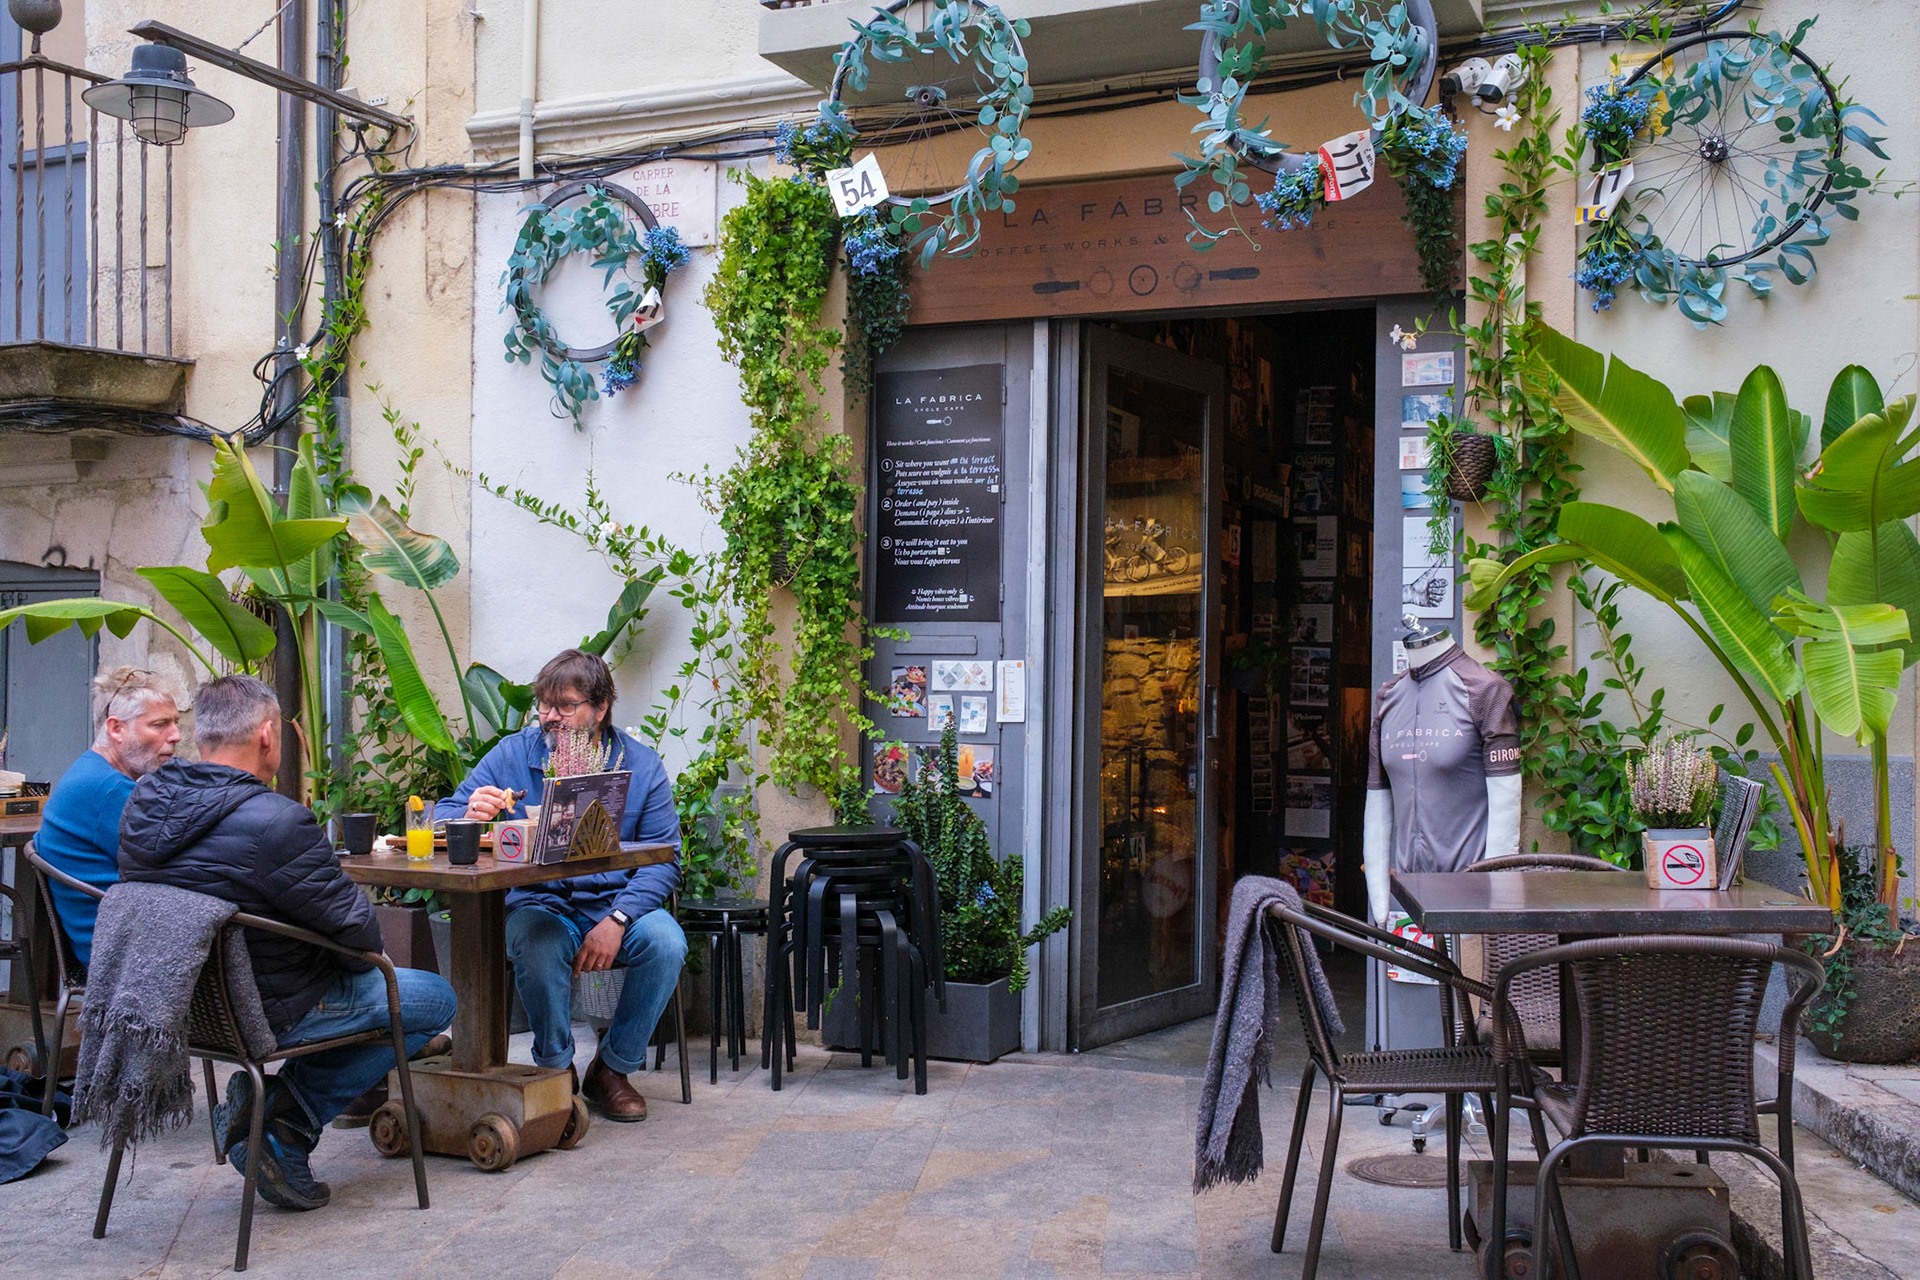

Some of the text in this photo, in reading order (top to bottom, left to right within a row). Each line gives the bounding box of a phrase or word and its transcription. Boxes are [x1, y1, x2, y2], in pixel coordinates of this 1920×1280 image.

[1331, 143, 1371, 188] 177
[632, 168, 674, 181] CARRER
[636, 184, 670, 196] DE LA
[840, 170, 877, 206] 54
[626, 202, 680, 221] LBRE
[1003, 208, 1049, 228] LA
[1064, 236, 1138, 250] WORKS
[1154, 234, 1168, 245] &
[896, 394, 982, 405] LA FABRICA
[895, 460, 904, 468] Sit
[1294, 454, 1336, 468] Cyling
[895, 470, 907, 478] Pots
[897, 487, 924, 495] terrasse
[942, 498, 959, 506] inside
[1108, 516, 1198, 540] LA FABRICA
[918, 539, 933, 548] bring
[934, 538, 939, 546] it
[956, 539, 968, 547] you
[894, 548, 902, 556] Us
[918, 588, 933, 596] Happy
[947, 588, 957, 596] only
[1397, 729, 1463, 738] FABRICA
